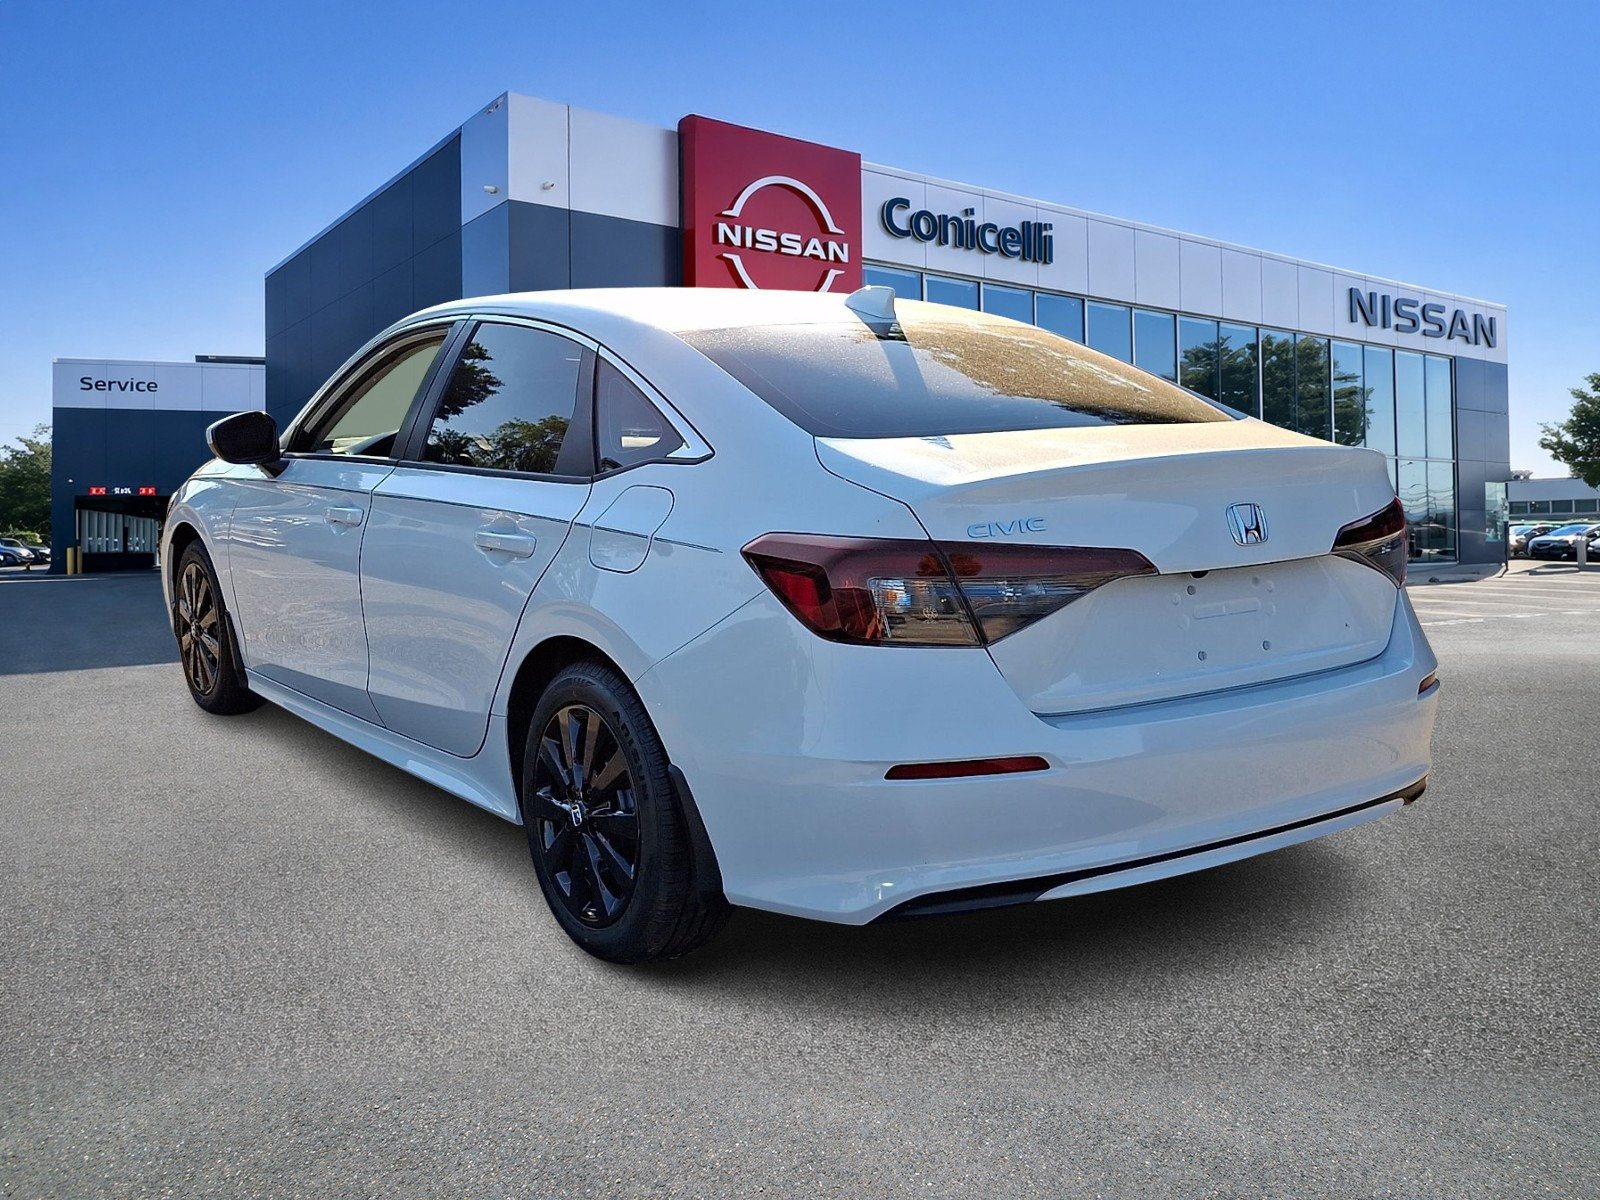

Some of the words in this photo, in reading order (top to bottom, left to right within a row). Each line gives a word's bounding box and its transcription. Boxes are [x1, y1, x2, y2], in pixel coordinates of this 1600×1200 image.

[716, 221, 849, 264] NISSAN
[881, 196, 1055, 265] Conicelli
[1348, 287, 1497, 348] NISSAN
[79, 376, 158, 393] Service
[966, 516, 1047, 539] CIVIC
